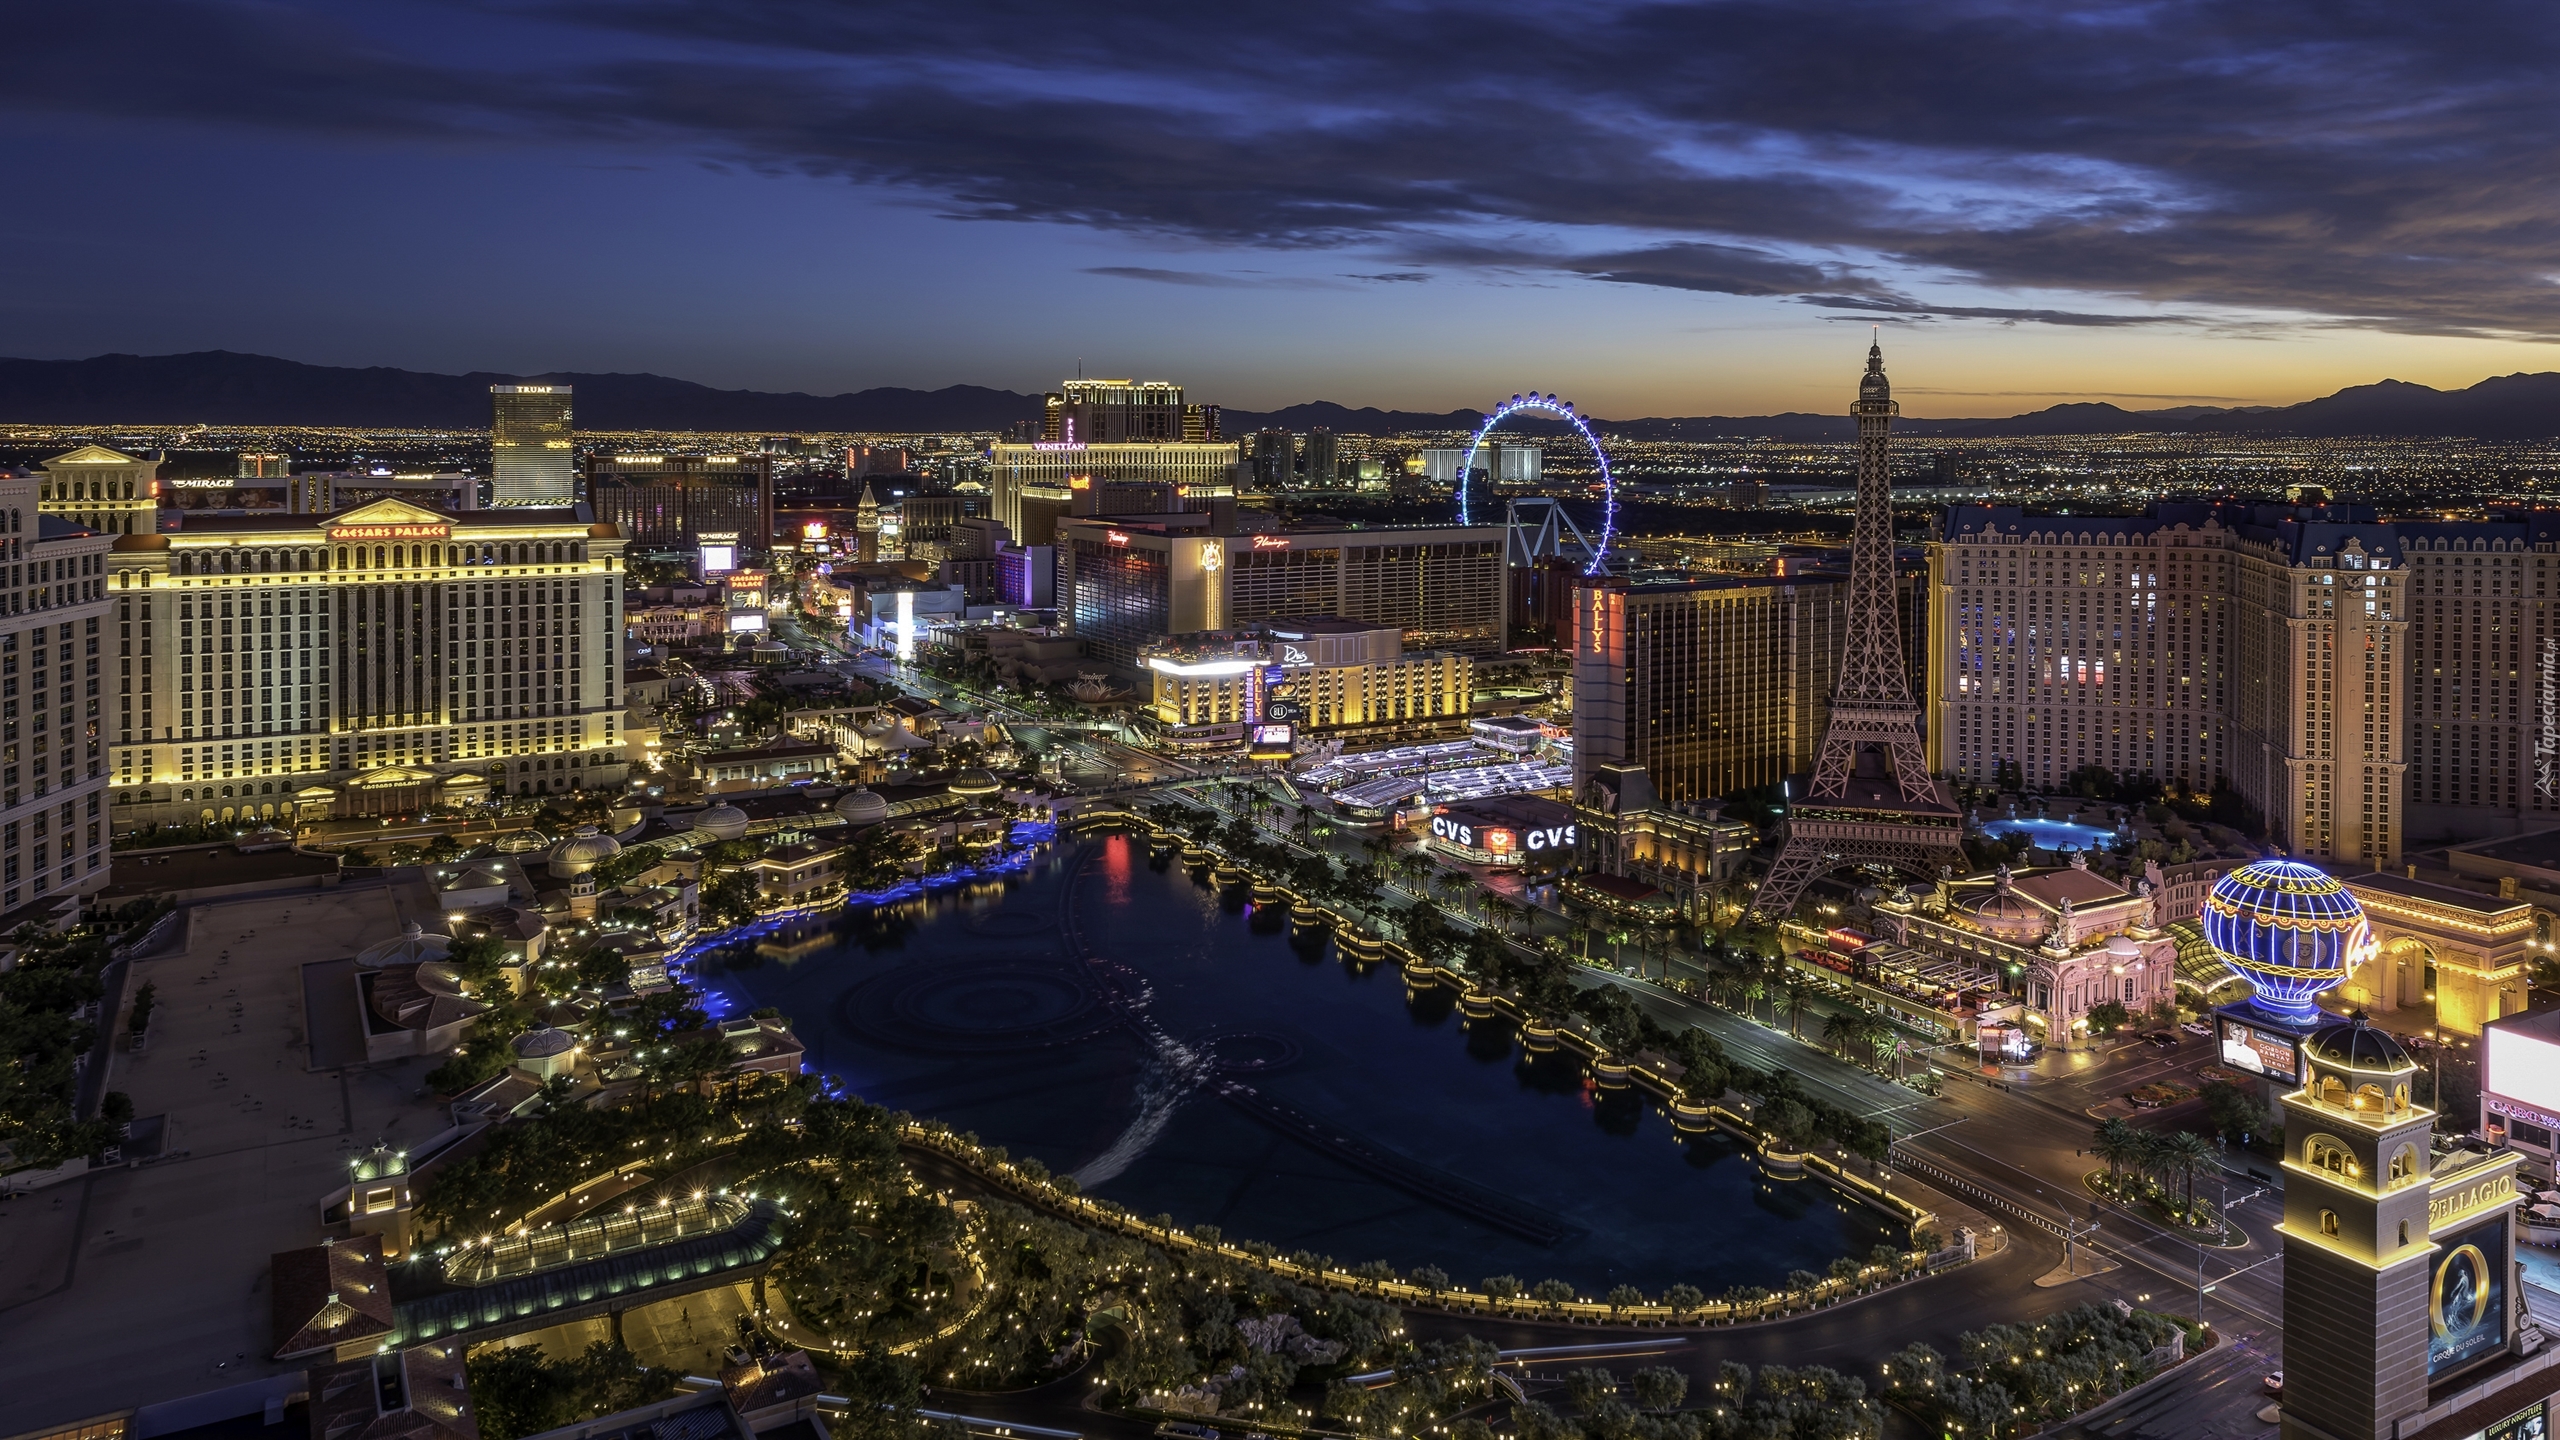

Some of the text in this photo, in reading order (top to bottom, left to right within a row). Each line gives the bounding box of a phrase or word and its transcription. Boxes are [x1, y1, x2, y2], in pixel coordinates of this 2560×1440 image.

[331, 526, 446, 537] CAESARS PALACE
[1253, 536, 1290, 548] Flamingo
[1273, 706, 1284, 716] BLT
[1432, 817, 1471, 846] CVS
[1527, 825, 1575, 850] CVS
[2351, 889, 2422, 910] MONUMENTAL
[2429, 906, 2476, 922] FLAVORS
[1827, 930, 1863, 947] BEER PARK
[2259, 1043, 2291, 1057] GORDON
[2259, 1048, 2291, 1063] RAMSAY
[2488, 1100, 2541, 1122] CABO
[2432, 1333, 2486, 1363] CIRQUE DU SOLEIL
[2488, 1418, 2512, 1437] LUXURY
[2510, 1402, 2543, 1425] NIGHTLIFE
